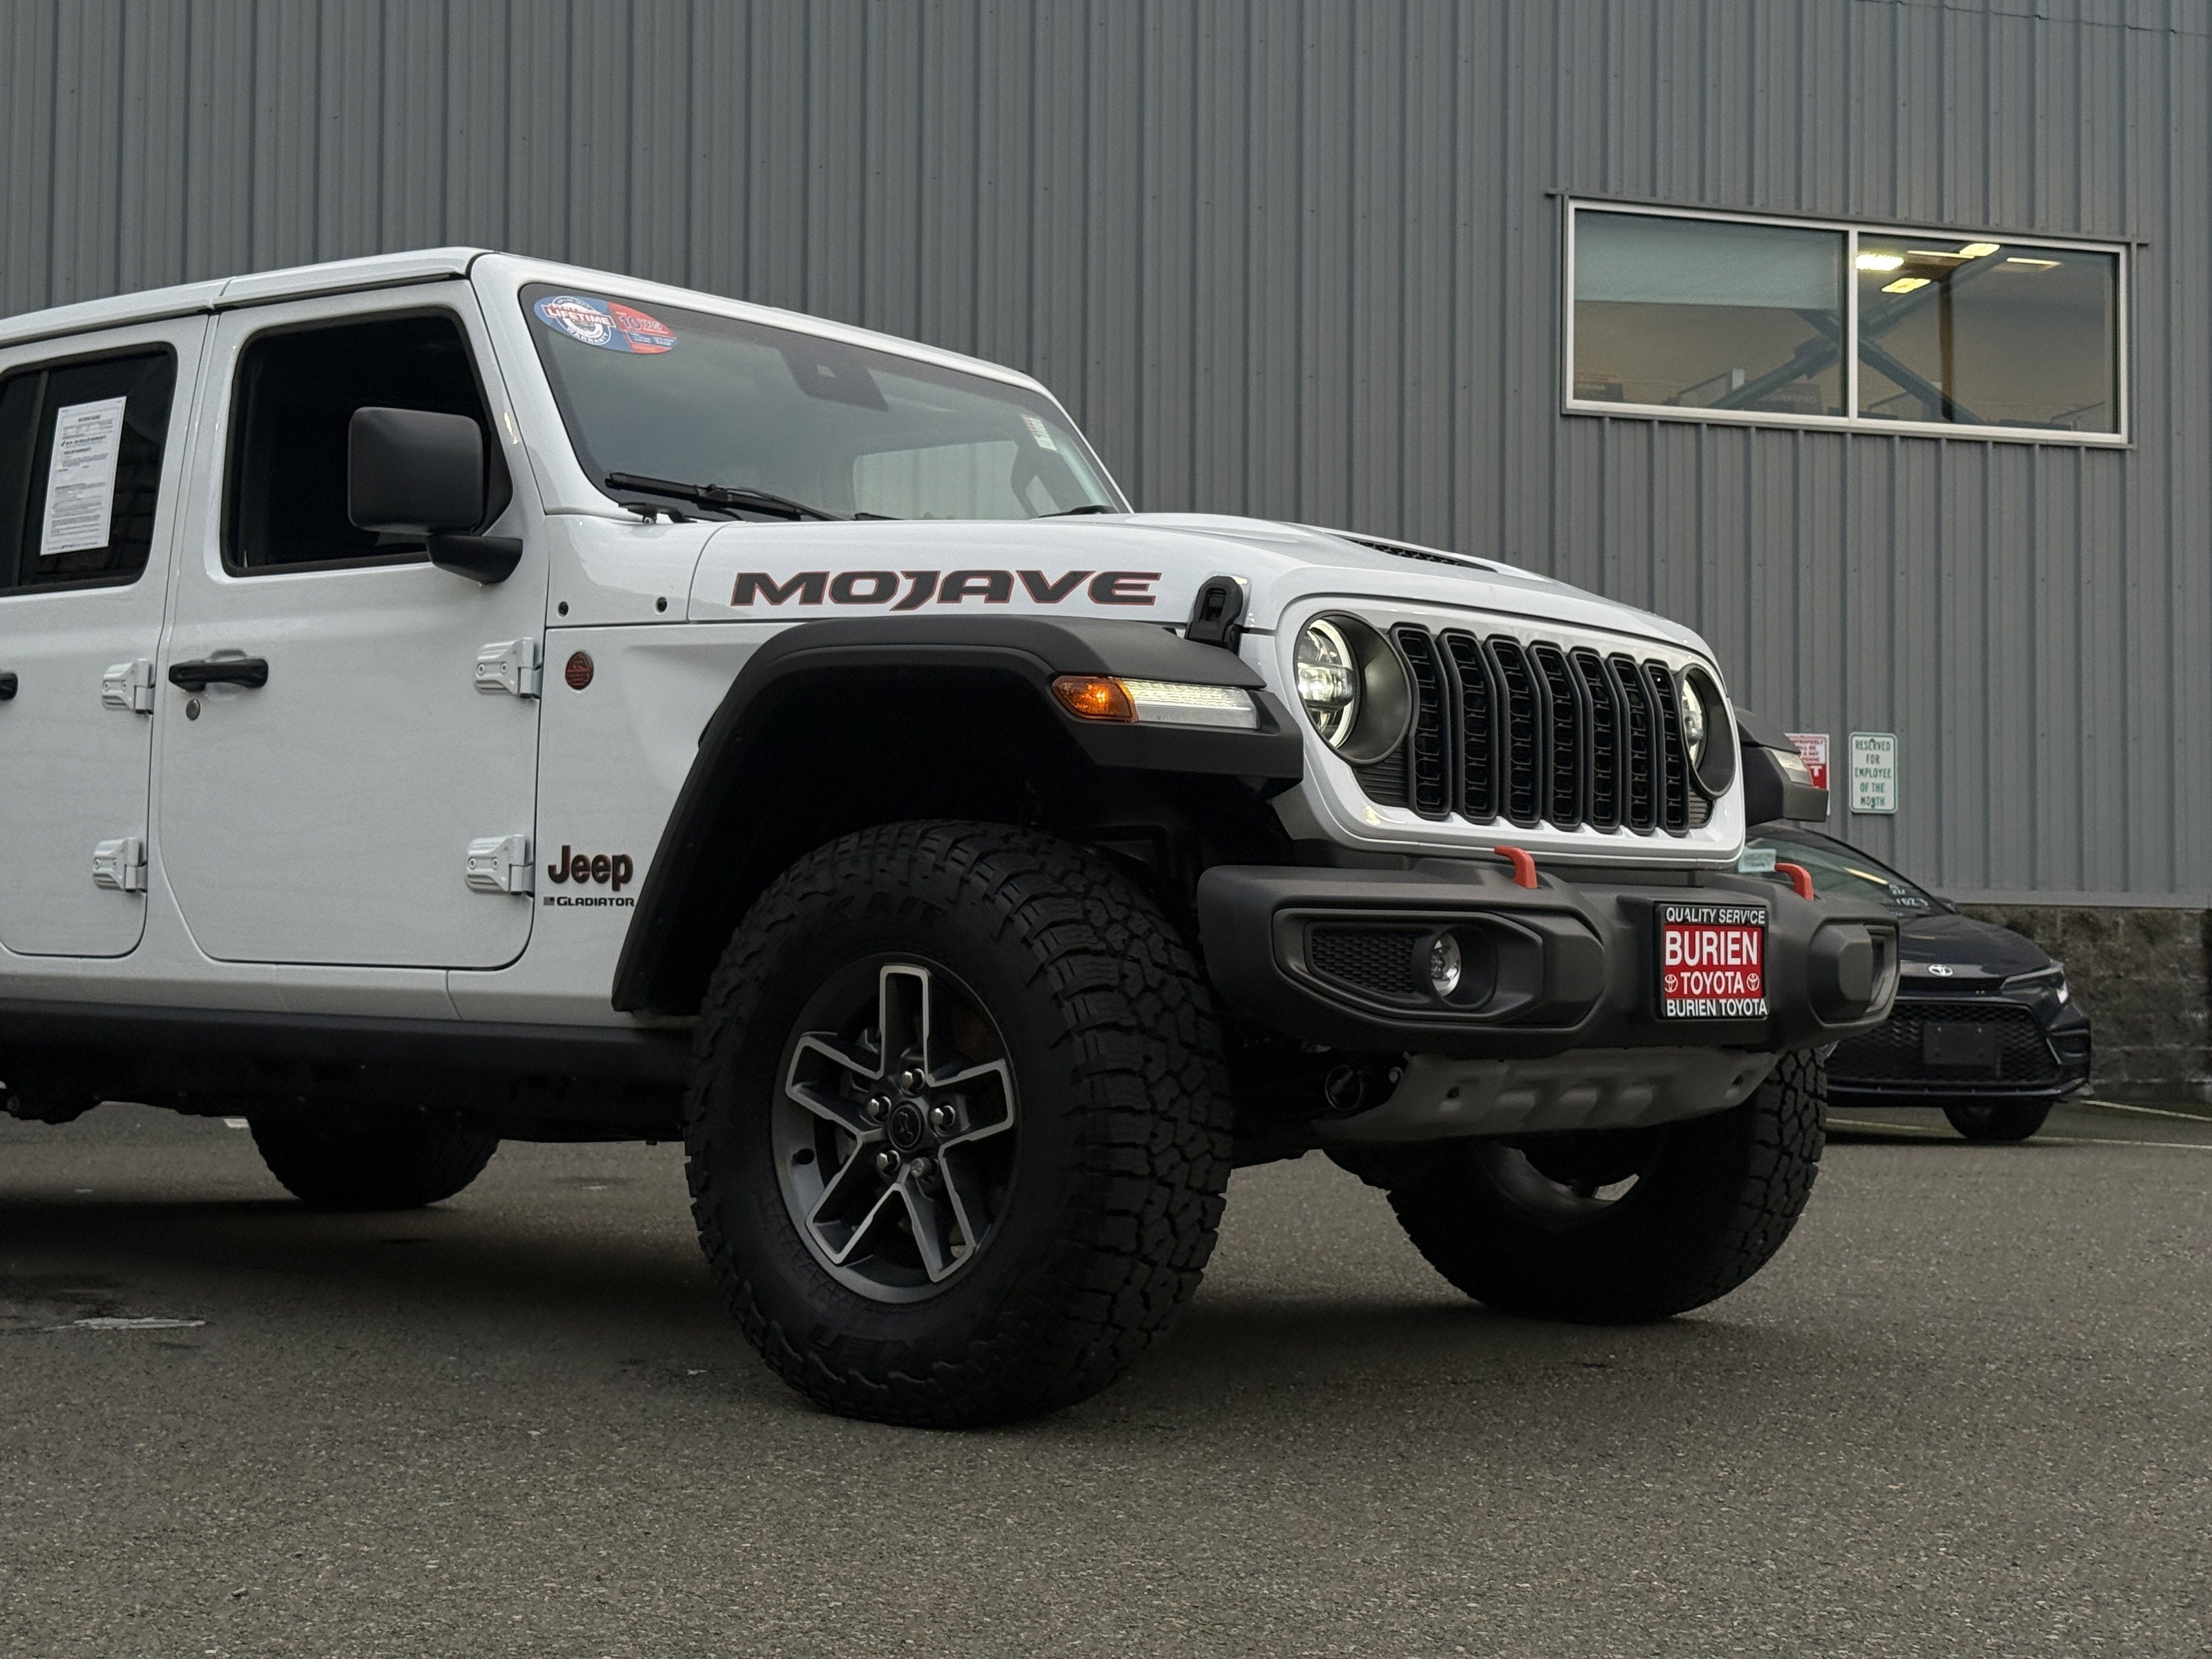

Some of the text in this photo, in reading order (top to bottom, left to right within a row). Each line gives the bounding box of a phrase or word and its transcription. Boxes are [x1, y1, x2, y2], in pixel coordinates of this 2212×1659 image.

[548, 308, 611, 325] LIFETIME
[567, 326, 609, 343] WARRANTY
[731, 570, 1163, 611] MOJAVE
[1855, 740, 1892, 752] RESERVED
[1866, 754, 1880, 764] FOR
[1854, 767, 1892, 779] EMPLOYEE
[1860, 782, 1885, 793] OF THE
[1860, 796, 1885, 806] MONTH
[548, 845, 634, 891] Jeep
[556, 896, 635, 907] GLADIATOR
[1666, 907, 1765, 924] QUALITY SERVICE
[1665, 930, 1758, 966] BURIEN
[1680, 970, 1745, 995] TOYOTA
[1666, 998, 1768, 1017] BURIEN TOYOTA
